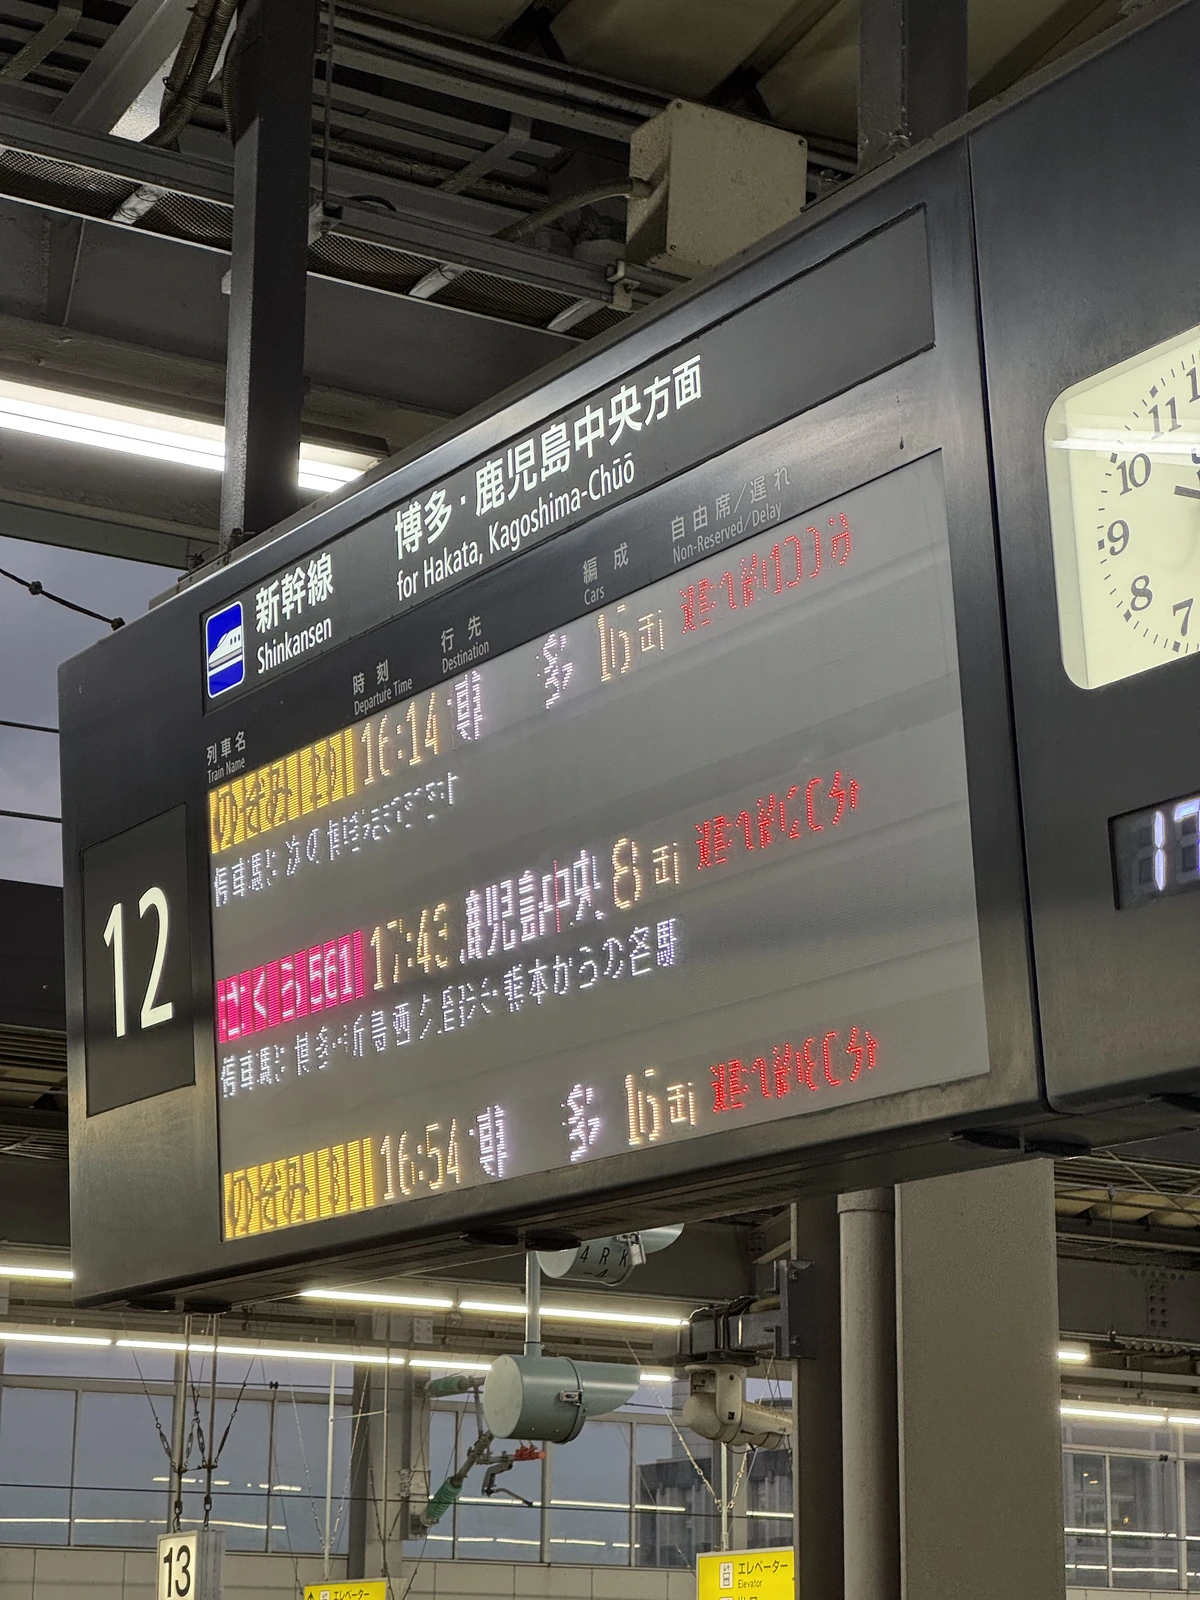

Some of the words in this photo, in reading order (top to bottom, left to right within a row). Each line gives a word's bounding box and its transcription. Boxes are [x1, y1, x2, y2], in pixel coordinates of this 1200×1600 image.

[1186, 367, 1200, 403] 1
[1148, 397, 1182, 440] 11
[395, 355, 703, 561] 博多・鹿児島中央方面
[1116, 453, 1151, 496] 10
[397, 569, 418, 602] for
[424, 541, 483, 590] Hakata,
[489, 452, 635, 554] Kagoshima-Chūō
[673, 502, 782, 564] Non-Reserved/Delay
[1107, 519, 1130, 556] 9
[583, 543, 628, 585] 編成
[255, 552, 334, 634] 新幹線
[584, 586, 605, 606] Cars
[1130, 575, 1153, 611] 8
[441, 615, 482, 654] 行先
[1172, 598, 1194, 637] 7
[257, 615, 332, 674] Shinkansen
[442, 640, 490, 674] Destination
[352, 659, 389, 696] 時刻
[354, 688, 392, 716] Departure
[393, 677, 413, 698] Time
[207, 731, 246, 766] 列車名
[361, 691, 439, 786] 16:14
[207, 765, 226, 784] Train
[226, 757, 246, 776] Name
[103, 886, 173, 1038] 12
[380, 1118, 461, 1201] 16:54
[163, 1544, 191, 1598] 13
[738, 1559, 789, 1575] エレベーター
[738, 1579, 763, 1589] Elevator
